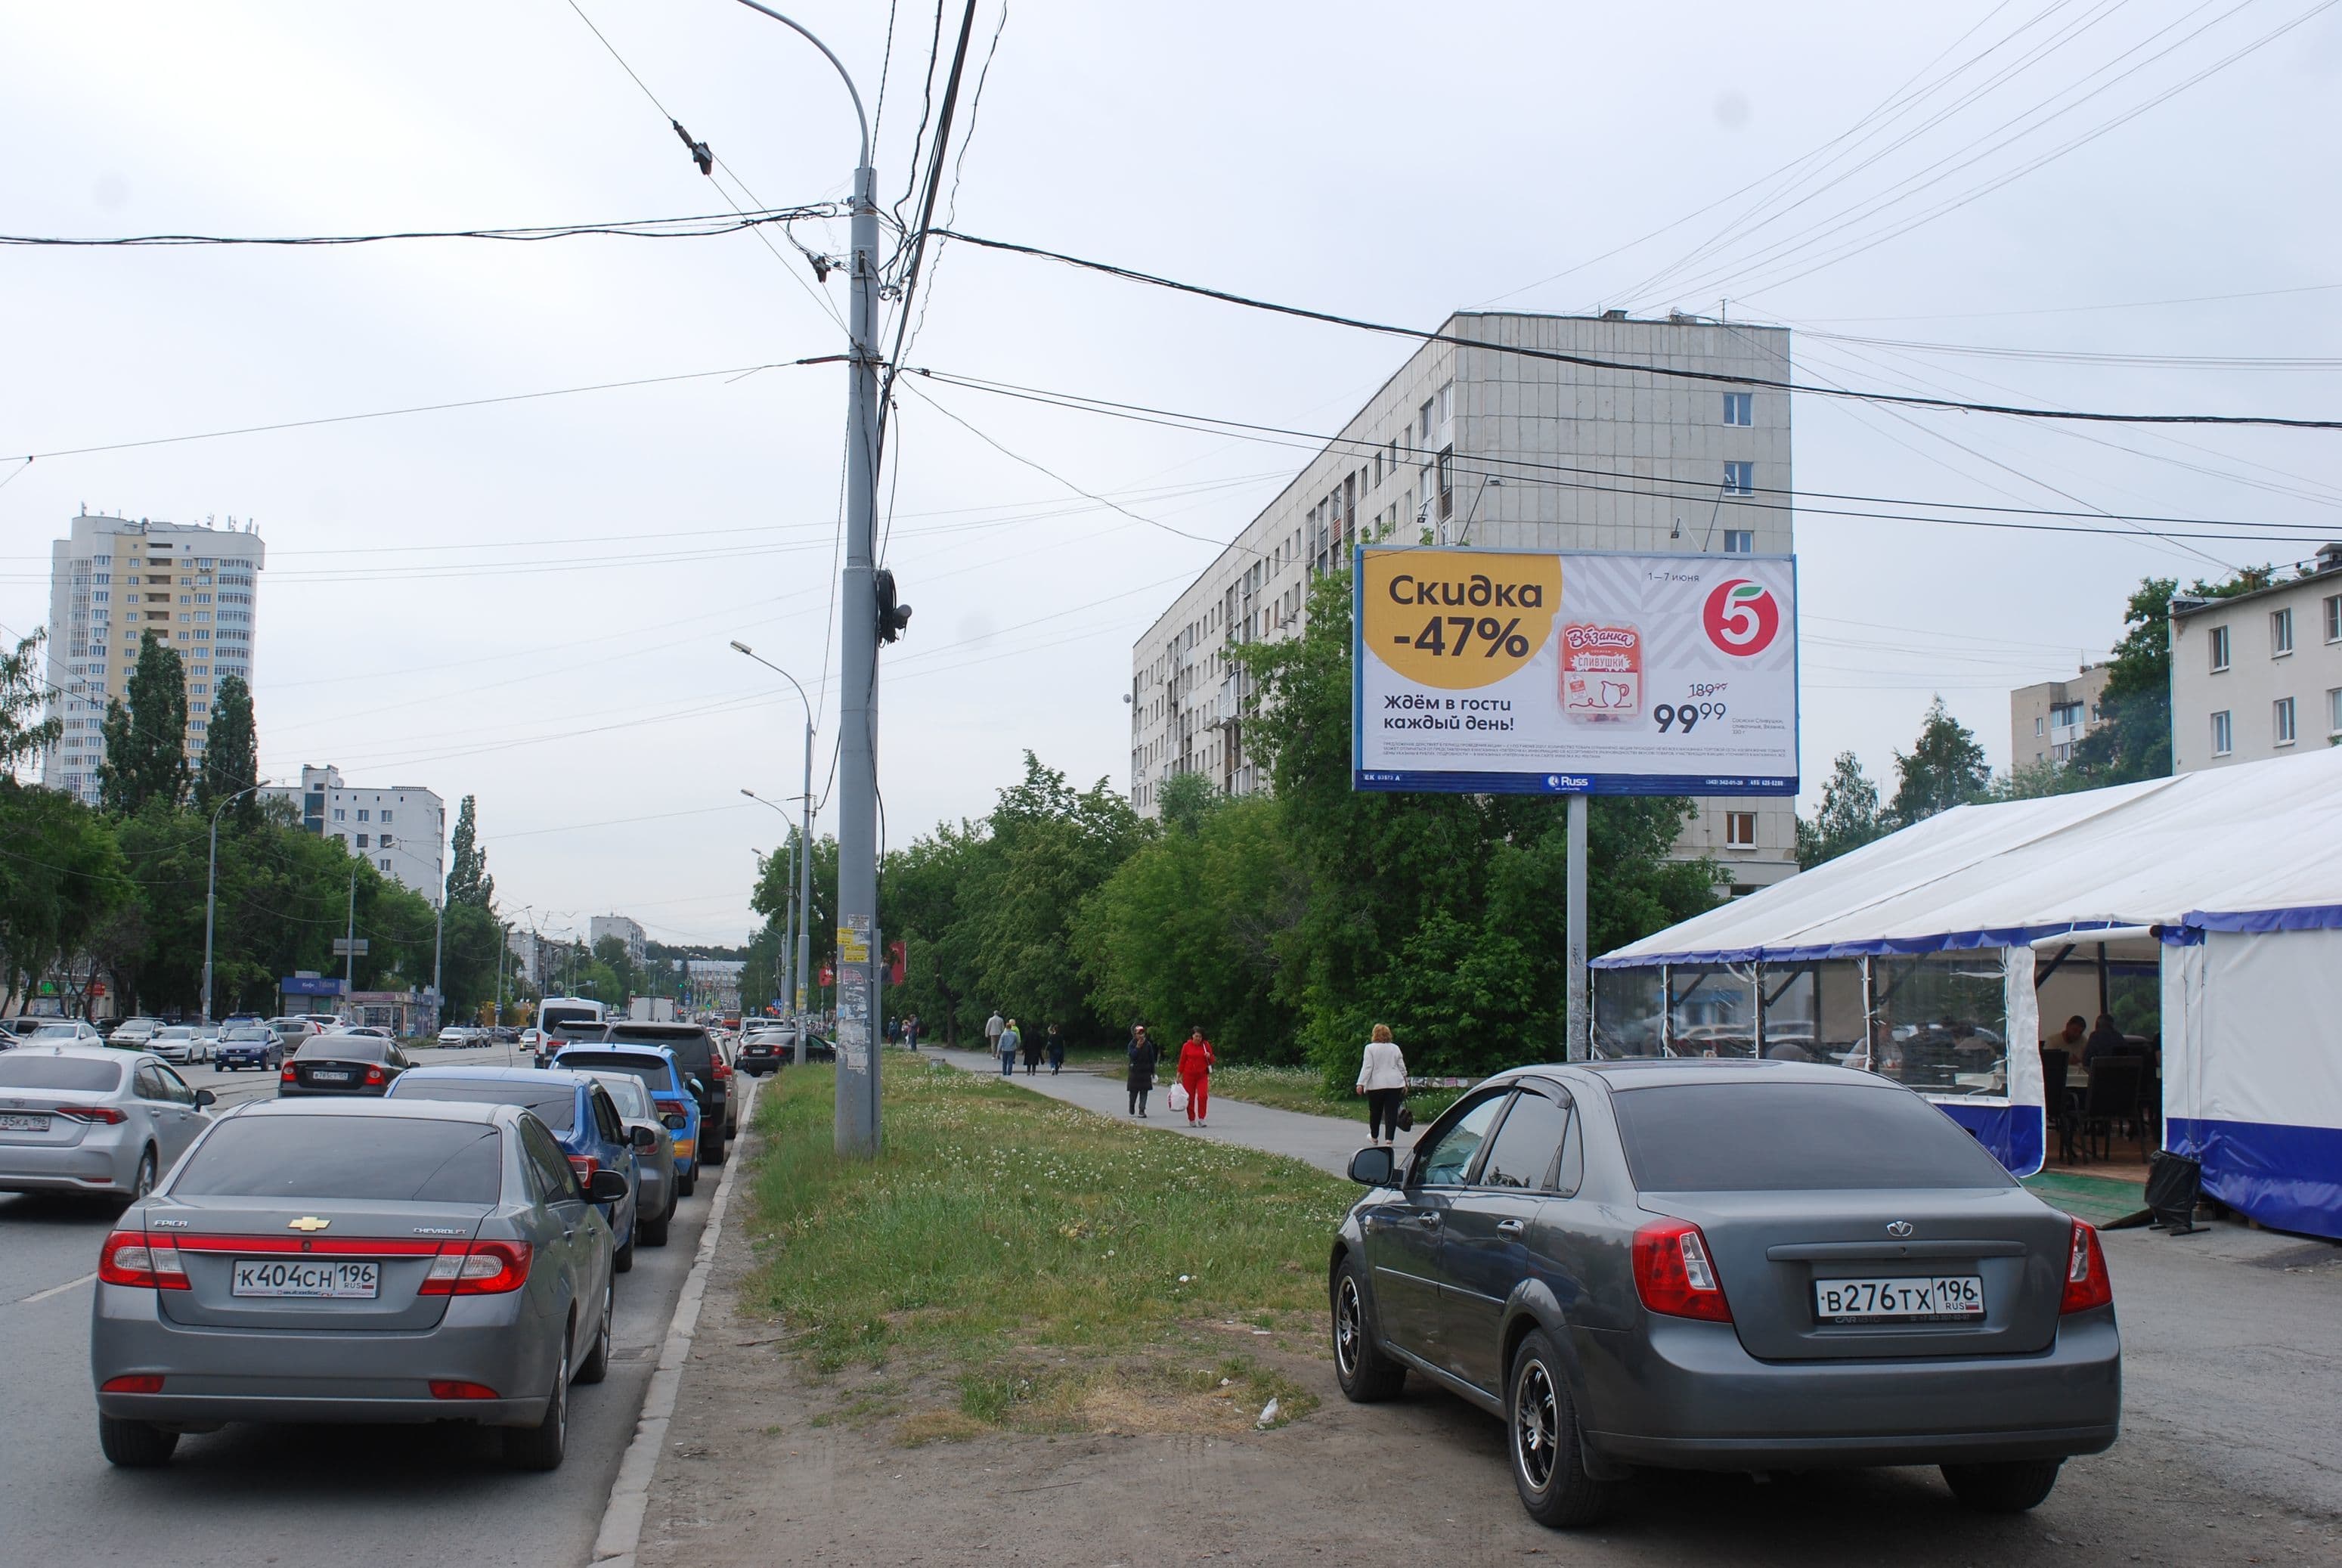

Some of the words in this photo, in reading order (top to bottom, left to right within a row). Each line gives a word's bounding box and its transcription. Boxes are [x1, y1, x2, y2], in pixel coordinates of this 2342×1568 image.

[1671, 573, 1700, 581] июня
[1389, 574, 1542, 608] Скидка
[1393, 615, 1529, 658] -47%
[1566, 627, 1635, 648] Вязанка
[1578, 657, 1624, 668] СЛИВУШКИ
[1383, 694, 1439, 709] Ждём
[1445, 699, 1455, 710] в
[1461, 699, 1511, 711] гости
[1383, 714, 1460, 730] каждый
[1465, 715, 1514, 731] день!
[1561, 776, 1588, 786] Russ
[0, 1116, 29, 1126] 35КА
[154, 1219, 188, 1228] EPICA
[338, 1264, 372, 1282] 196
[1936, 1279, 1975, 1301] 196
[1945, 1302, 1965, 1310] RUS
